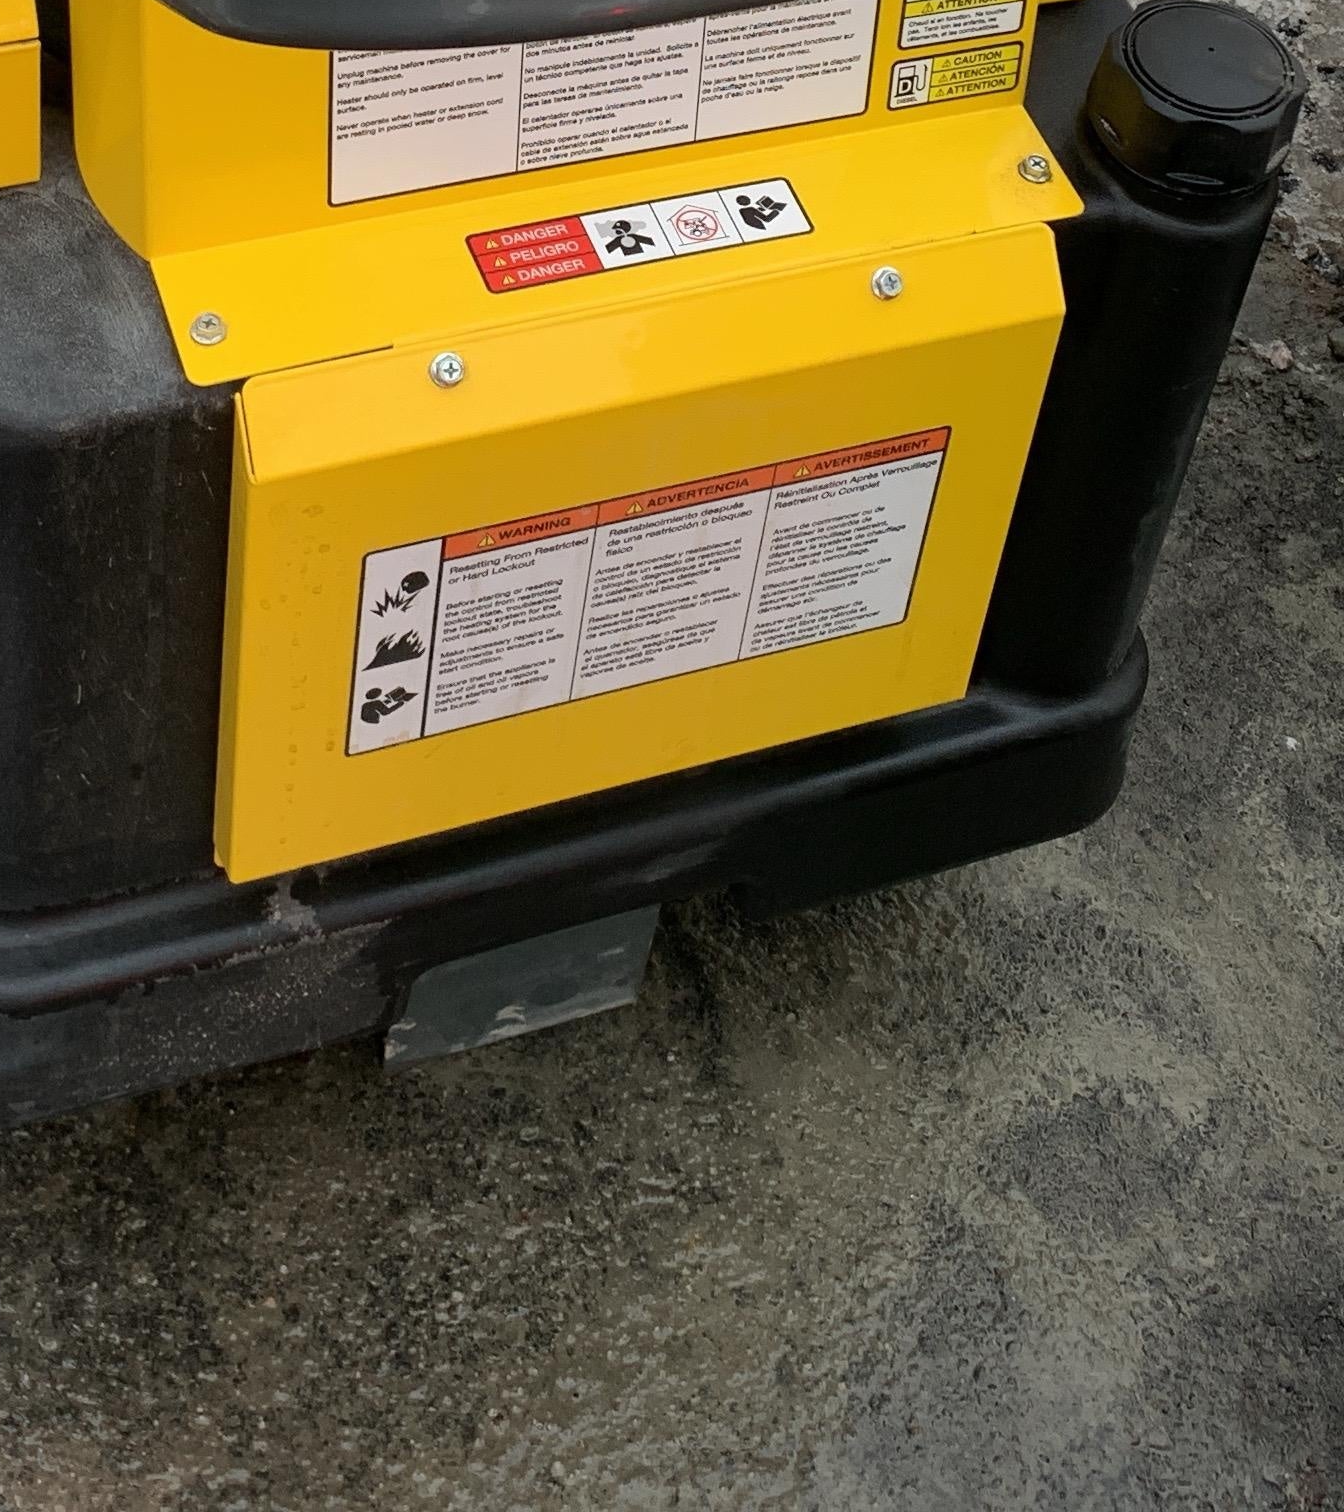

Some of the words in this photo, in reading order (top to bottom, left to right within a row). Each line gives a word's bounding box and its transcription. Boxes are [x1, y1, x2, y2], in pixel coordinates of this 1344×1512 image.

[336, 67, 365, 82] Unplug
[365, 62, 399, 76] machine
[399, 58, 425, 71] before
[425, 52, 462, 69] removing
[462, 50, 476, 61] the
[476, 48, 498, 59] cover
[949, 62, 1005, 81] ATENCIÓN
[953, 50, 1002, 66] CAUTION
[336, 80, 351, 91] any
[352, 69, 405, 86] maintenance.
[898, 79, 912, 95] D
[946, 77, 1006, 96] ATTENTION
[500, 223, 568, 247] DANGER
[509, 240, 580, 264] PELIGRO
[518, 258, 585, 283] DANGER
[813, 438, 930, 471] AVERTISSEMENT
[848, 469, 880, 487] Après
[879, 456, 938, 480] Verrouillage
[647, 477, 749, 508] ADVERTENCIA
[772, 490, 820, 510] Restreint
[819, 487, 838, 500] Ou
[836, 477, 882, 498] Complet
[498, 516, 572, 541] WARNING
[606, 535, 622, 547] de
[622, 532, 644, 544] una
[709, 505, 754, 526] bloqueo
[607, 508, 700, 538] Restablecimiento
[699, 498, 746, 520] después
[448, 554, 502, 577] Resetting
[502, 547, 533, 563] From
[533, 534, 590, 556] Restricted
[447, 575, 461, 585] or
[461, 566, 490, 582] Hard
[490, 556, 537, 575] Lockout
